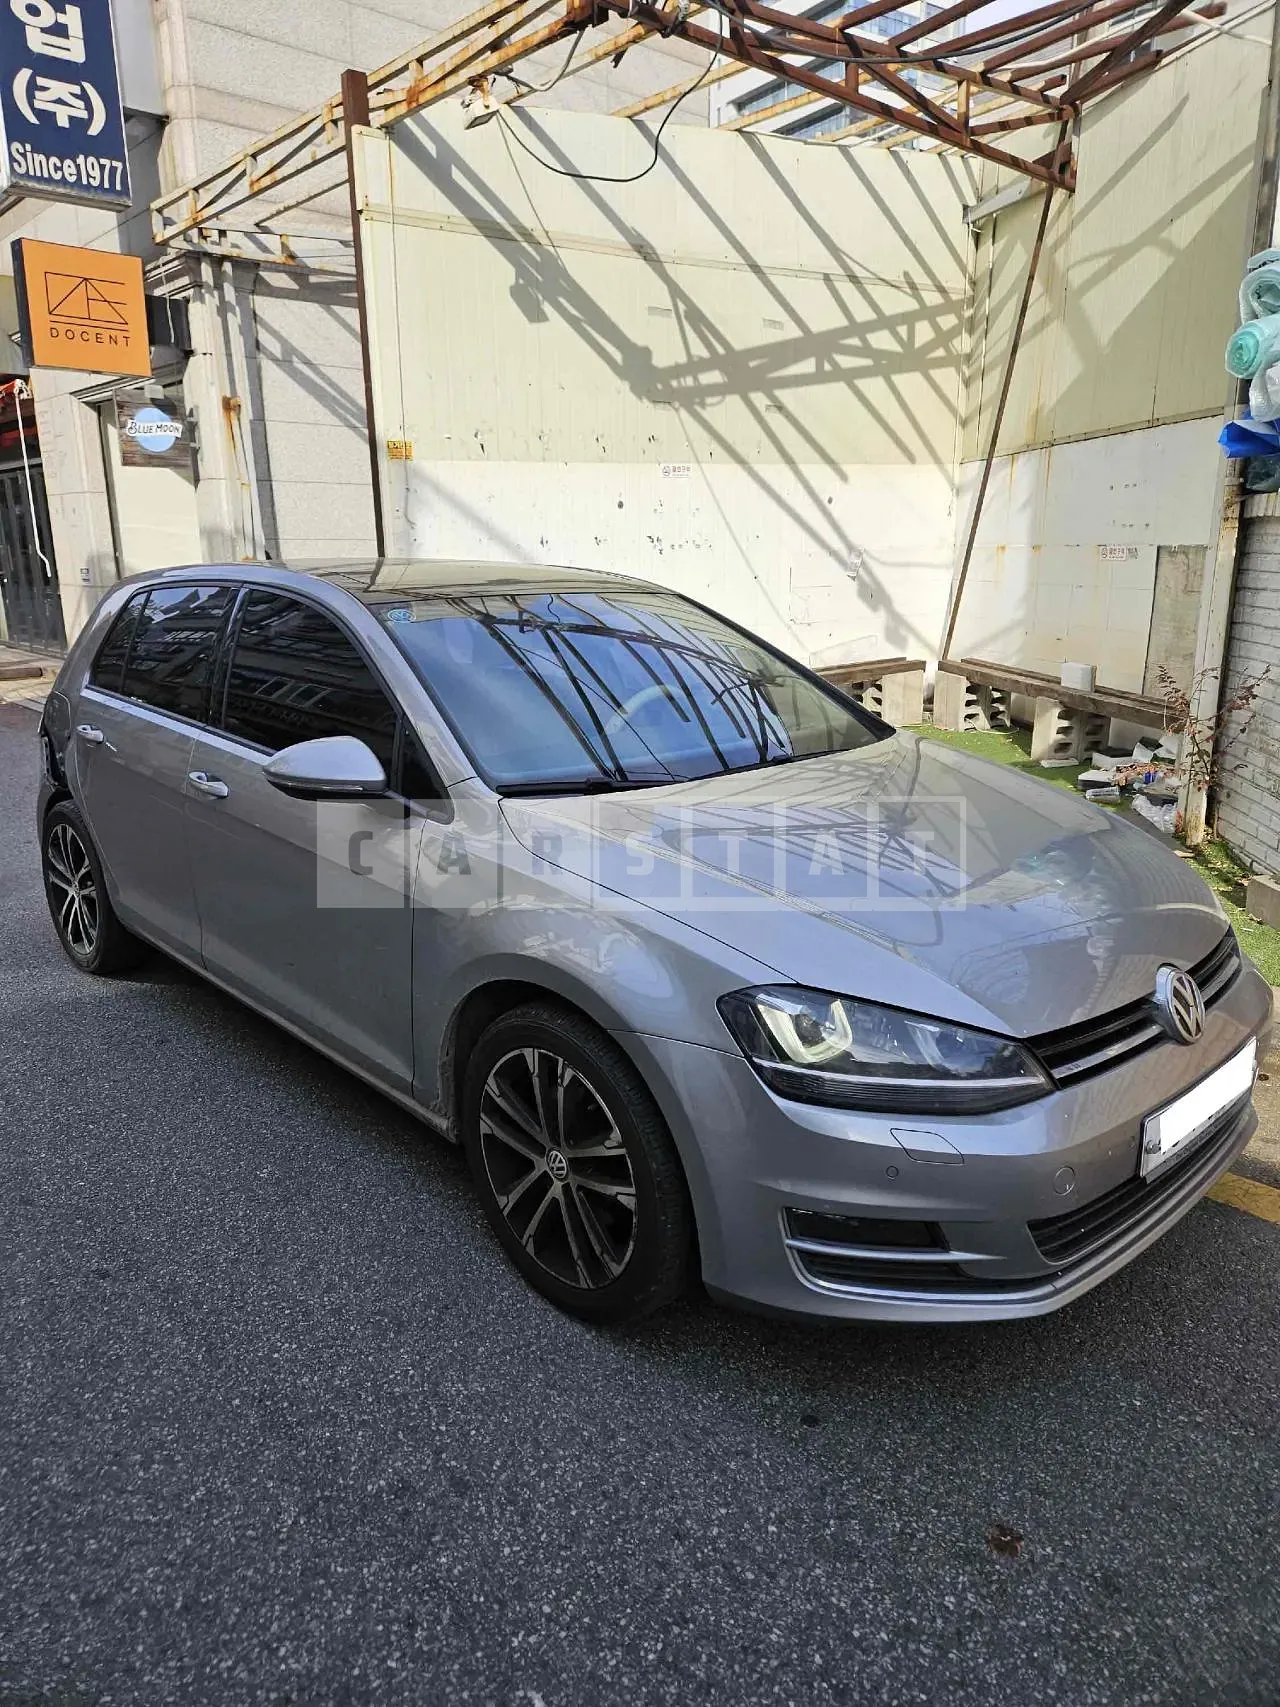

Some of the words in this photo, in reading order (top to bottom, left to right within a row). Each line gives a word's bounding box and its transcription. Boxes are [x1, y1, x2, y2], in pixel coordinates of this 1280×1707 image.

[10, 141, 123, 191] Since1977
[50, 327, 131, 347] DOCENT
[128, 421, 153, 435] BLUE
[155, 423, 179, 433] MOON
